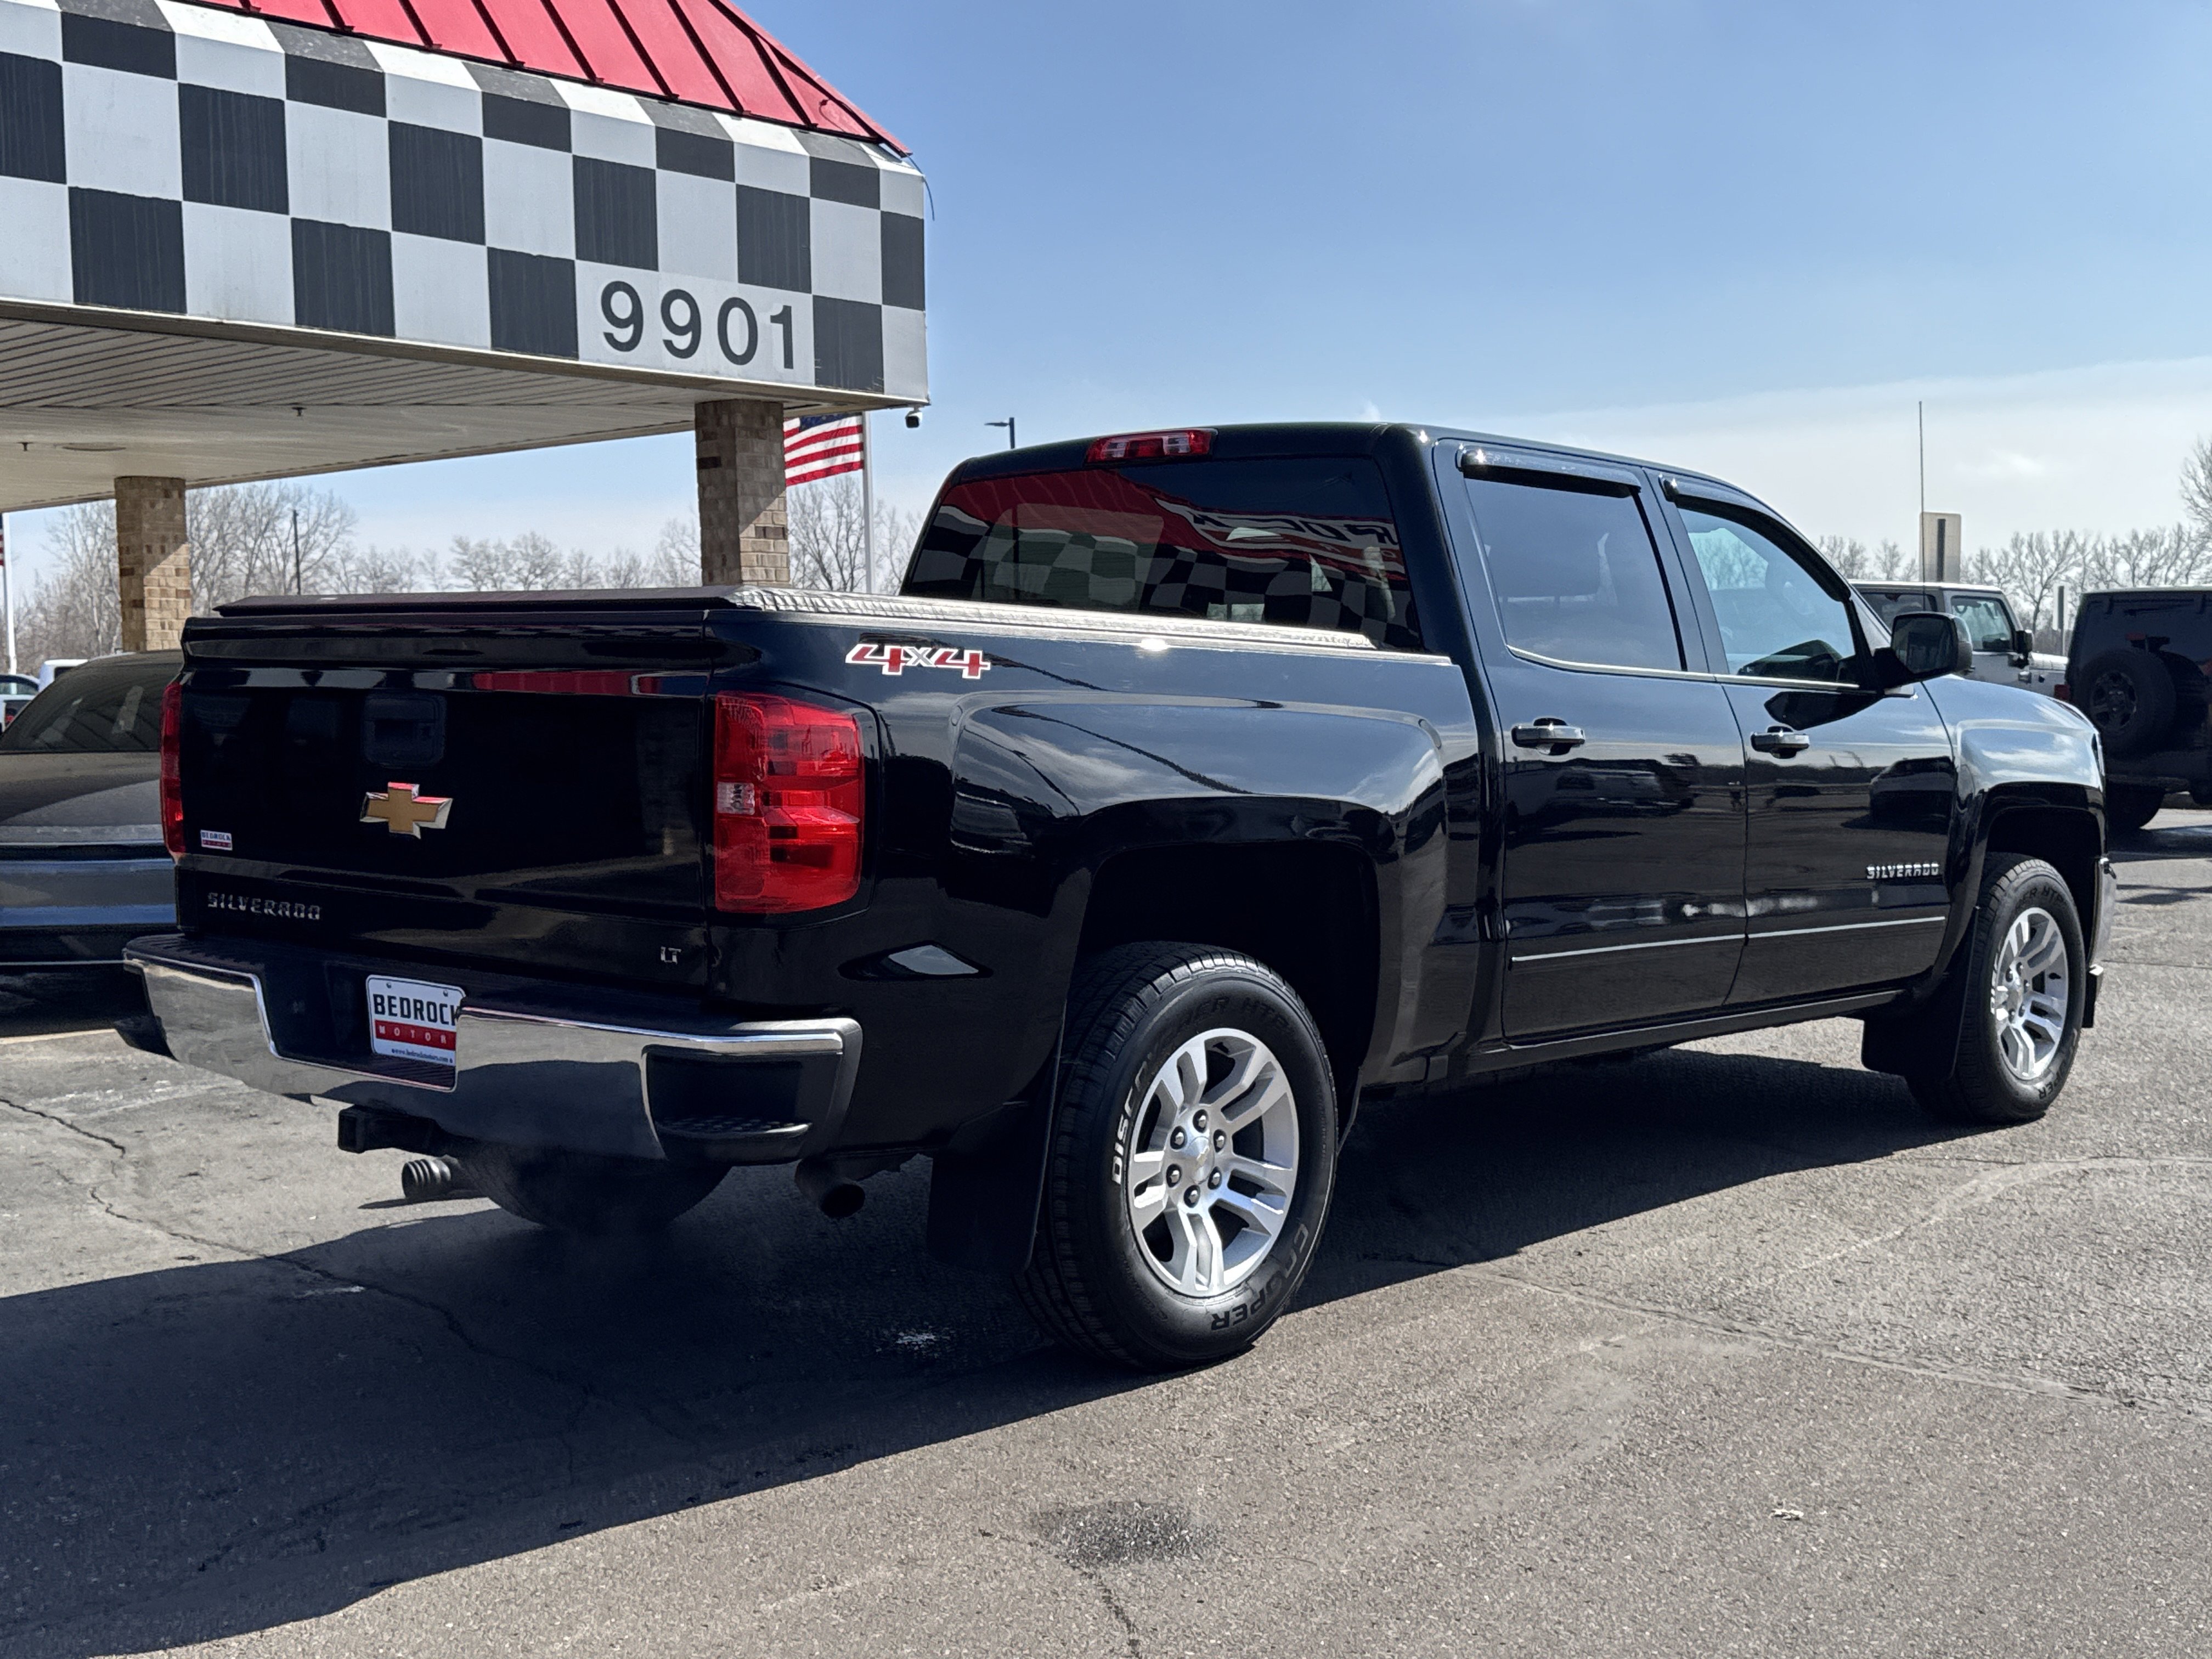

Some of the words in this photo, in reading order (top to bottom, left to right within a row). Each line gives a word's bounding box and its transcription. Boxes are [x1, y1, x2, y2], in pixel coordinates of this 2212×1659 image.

[601, 280, 794, 370] 9901
[1866, 861, 1940, 879] SILVERADO
[208, 892, 321, 921] SILVERADO
[661, 946, 682, 965] LT
[1211, 1223, 1309, 1330] COOPER
